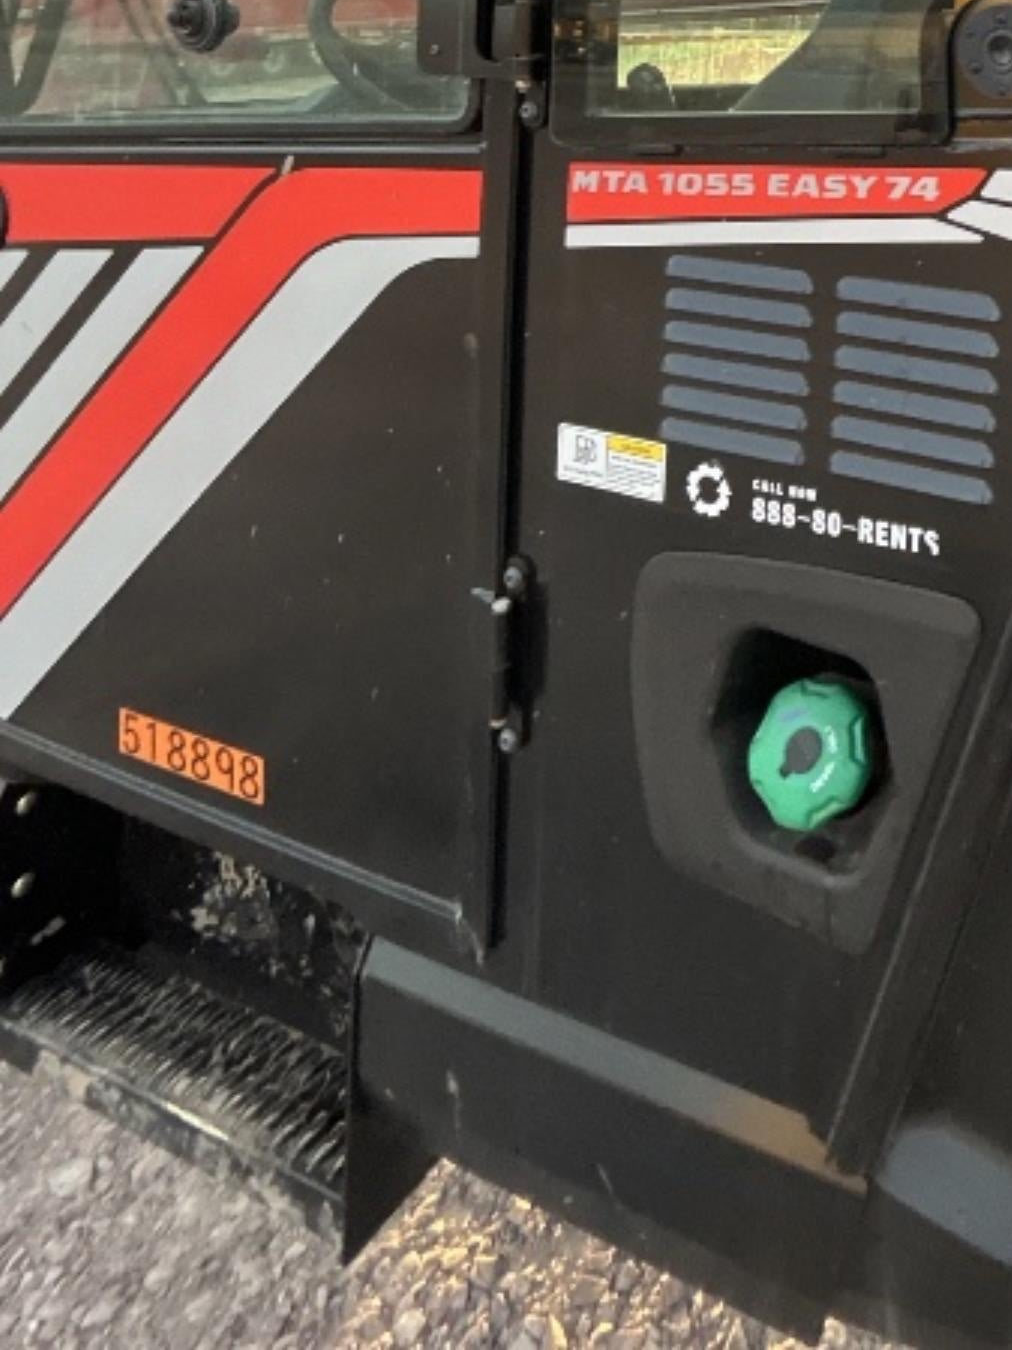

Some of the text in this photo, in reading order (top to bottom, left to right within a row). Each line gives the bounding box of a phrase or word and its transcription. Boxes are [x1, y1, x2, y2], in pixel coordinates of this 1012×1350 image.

[571, 169, 940, 204] MTA 1055 EASY 74
[752, 479, 784, 496] CALL
[752, 497, 940, 556] 888-80-RENTS
[122, 714, 259, 799] 518898
